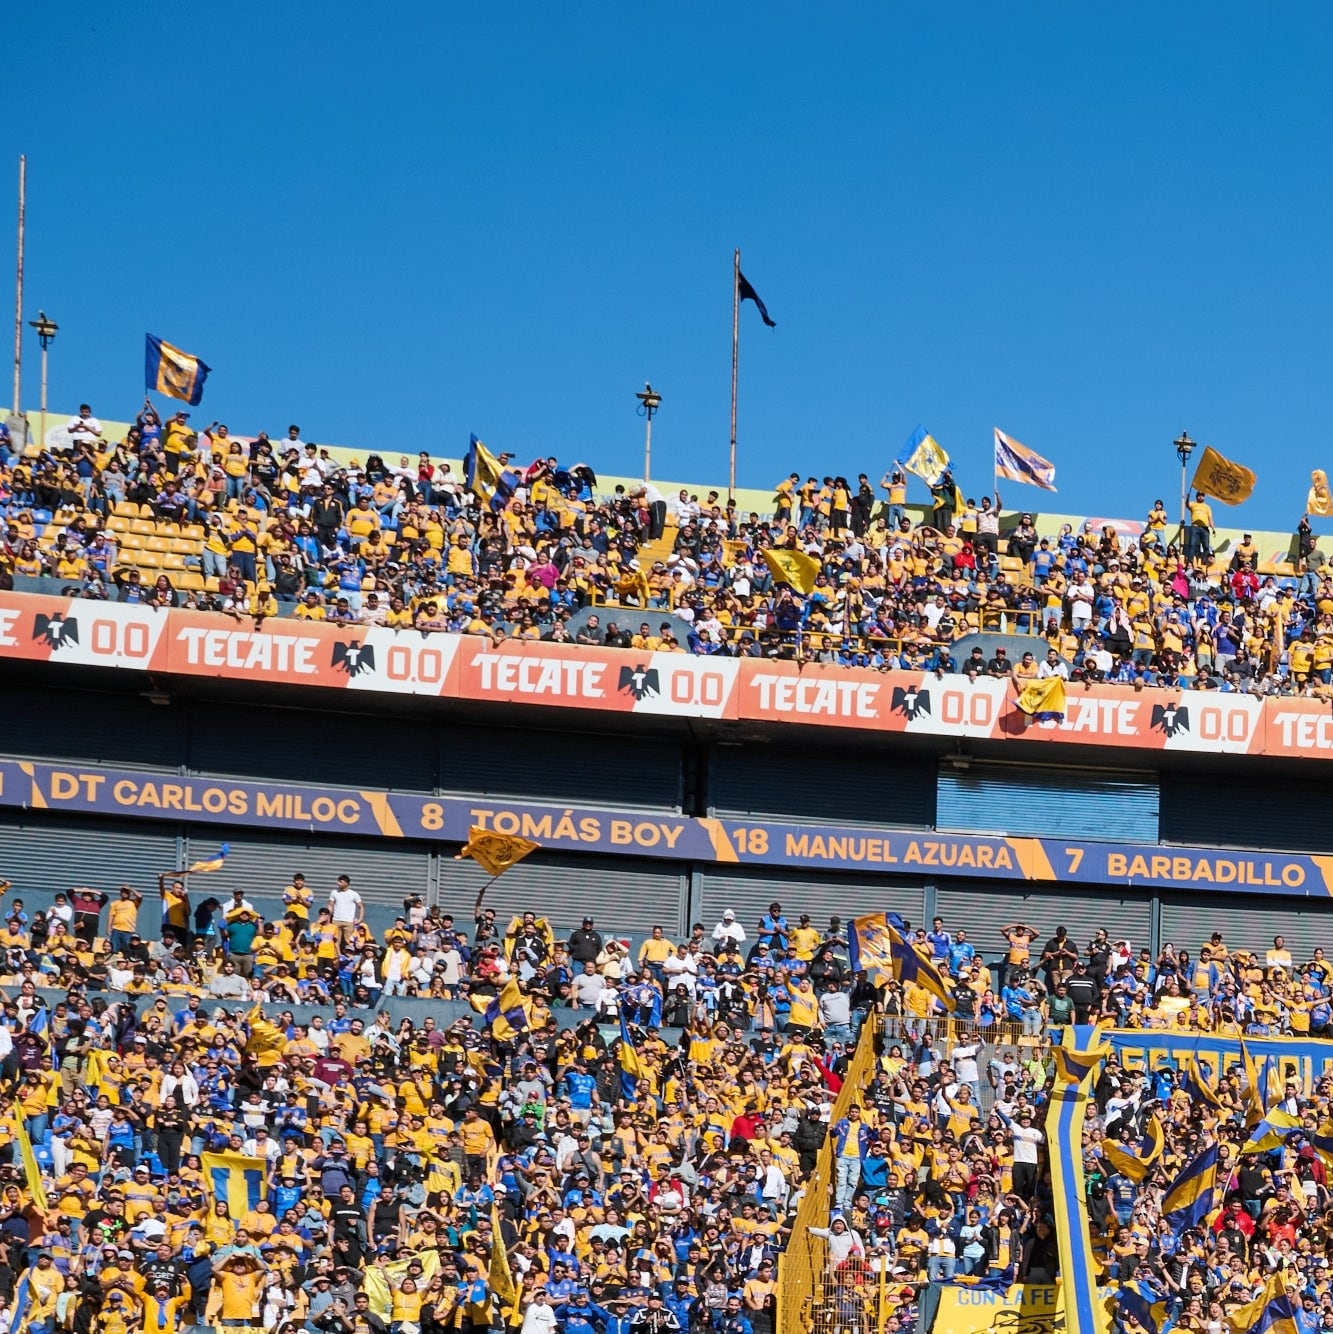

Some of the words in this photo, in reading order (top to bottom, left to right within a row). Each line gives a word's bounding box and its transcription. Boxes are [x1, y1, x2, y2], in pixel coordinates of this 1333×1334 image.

[92, 619, 149, 658] 0.0
[178, 627, 318, 674] TECATE
[386, 646, 440, 681] 0.0
[471, 653, 605, 697] TECATE
[671, 670, 724, 704] 0.0
[749, 673, 878, 718] TECATE
[942, 691, 990, 725] 0.0
[1017, 686, 1139, 734] CATE
[1199, 708, 1248, 741] 0.0
[50, 772, 104, 802] DT
[114, 779, 247, 815] CARLOS
[257, 794, 360, 824] MILOC
[421, 804, 443, 830] 8
[471, 808, 598, 842] TOMÁS
[610, 819, 683, 849] BOY
[732, 829, 769, 854] 18
[786, 834, 898, 863] MANUEL
[904, 842, 1012, 871] AZUARA
[1068, 850, 1083, 873] 7
[1108, 853, 1305, 888] BARBADILLO
[959, 1288, 994, 1306] CON
[1003, 1288, 1023, 1306] LA
[1031, 1288, 1055, 1306] FE
